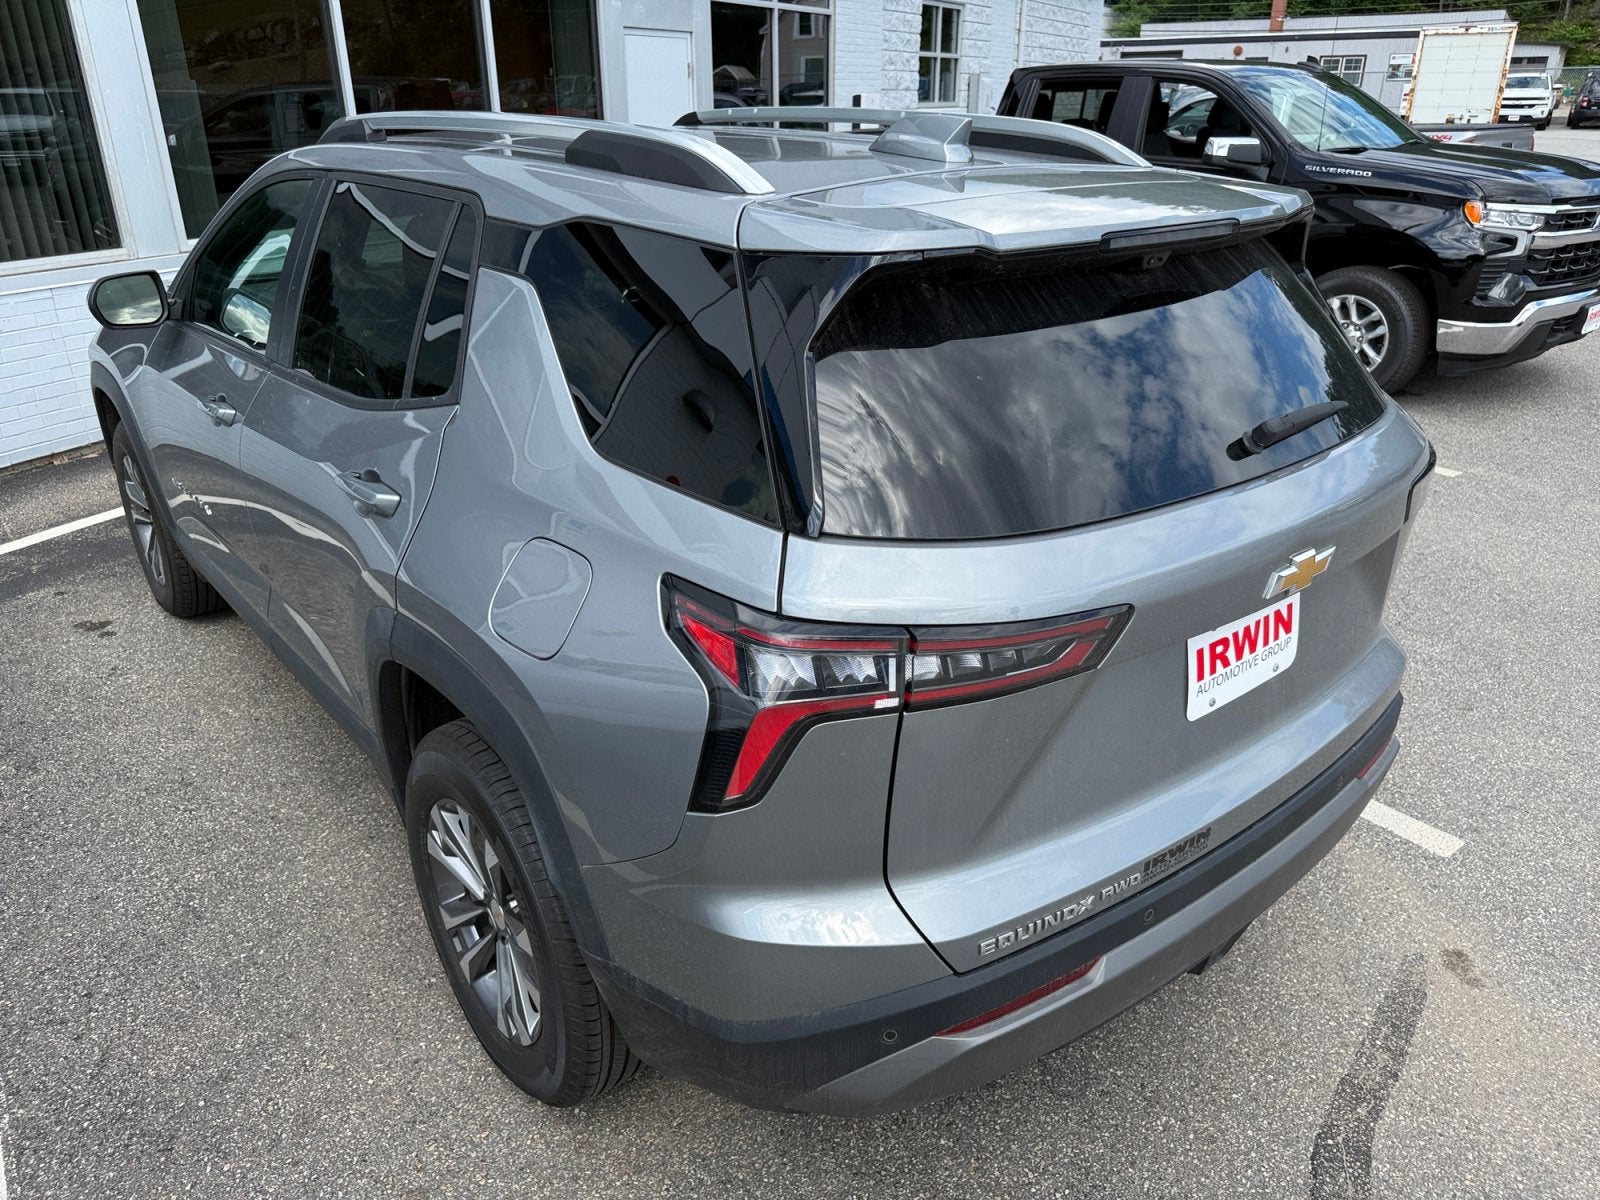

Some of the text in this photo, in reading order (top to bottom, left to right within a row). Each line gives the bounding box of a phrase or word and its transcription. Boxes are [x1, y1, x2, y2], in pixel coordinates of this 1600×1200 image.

[1304, 164, 1372, 178] SILVERADO
[1196, 602, 1293, 683] IRWIN
[1196, 636, 1292, 698] AUTOMOTIVE GROUP
[1143, 827, 1212, 873] IRWIN
[979, 895, 1095, 956] EQUINOX
